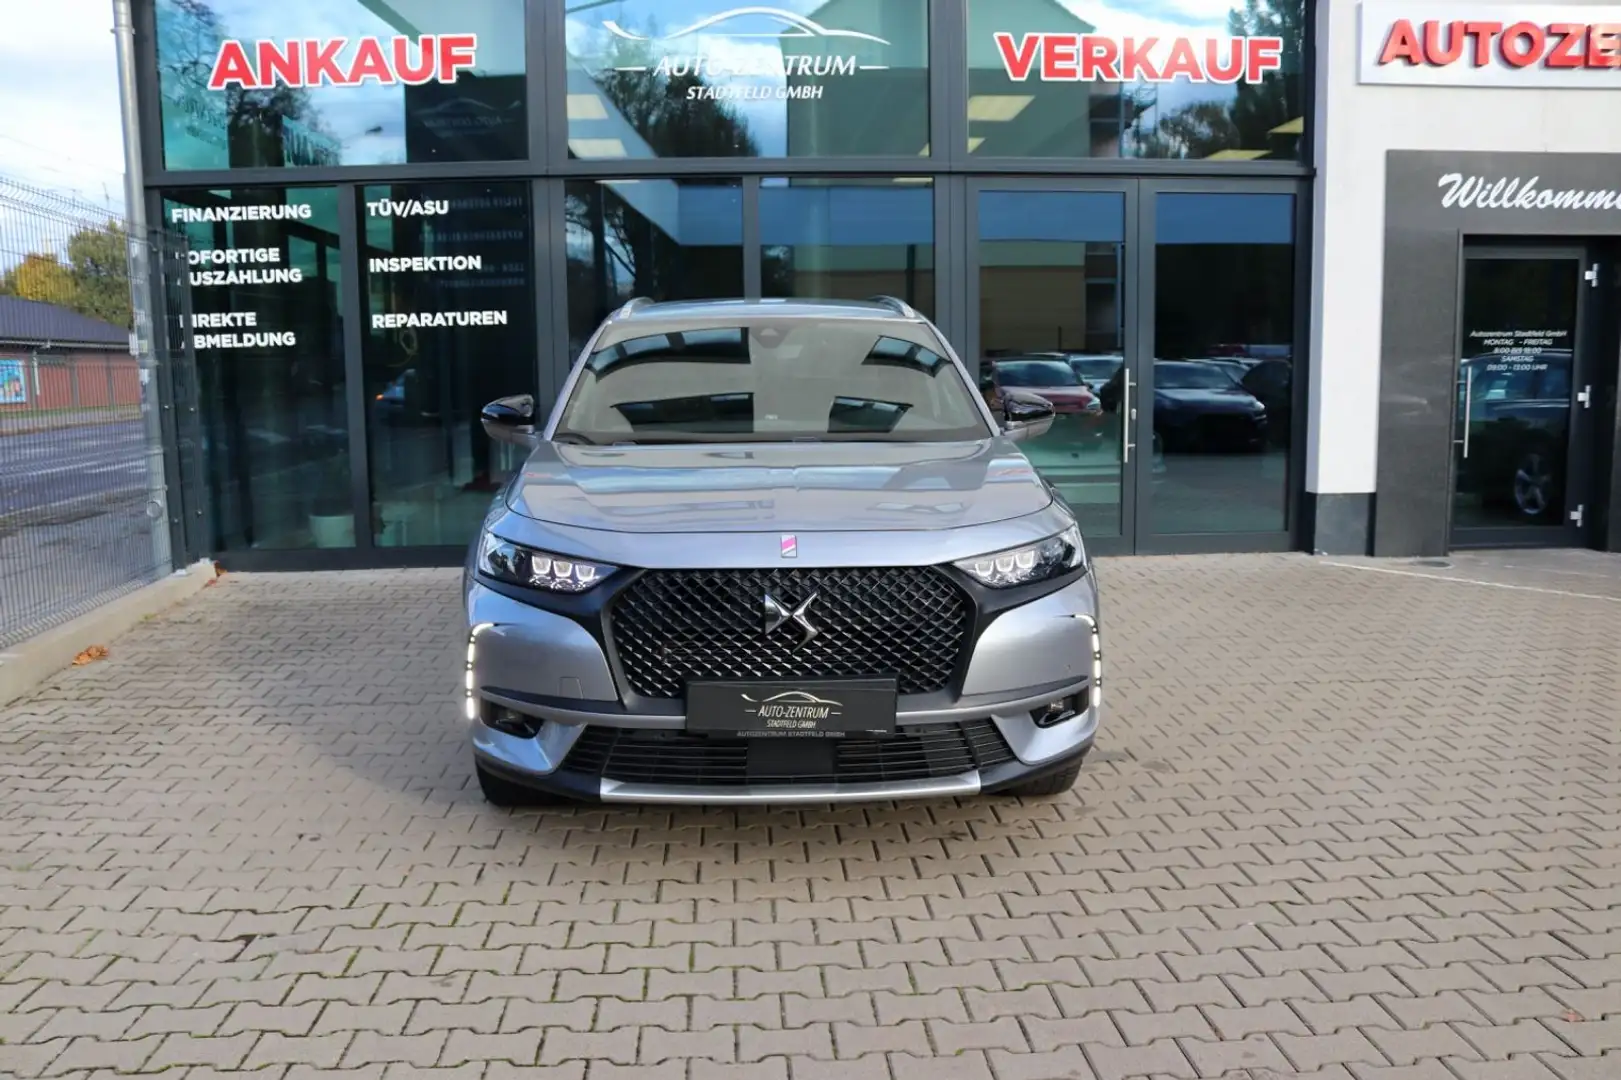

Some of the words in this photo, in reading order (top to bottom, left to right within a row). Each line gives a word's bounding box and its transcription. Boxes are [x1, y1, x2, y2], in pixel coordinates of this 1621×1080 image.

[1378, 18, 1621, 70] AUTOZE
[207, 33, 477, 90] ANKAUF
[993, 32, 1283, 84] VERKAUF
[687, 85, 771, 100] STADTFELD
[775, 85, 823, 99] GMBH
[171, 204, 312, 223] FINANZIERUNG
[366, 198, 449, 218] TÜV/ASU
[369, 255, 482, 273] INSPEKTION
[177, 268, 302, 286] USZAHLUNG
[371, 310, 508, 328] REPARATUREN
[181, 331, 296, 349] BMELDUNG
[758, 705, 829, 719] AUTO-ZENTRUM
